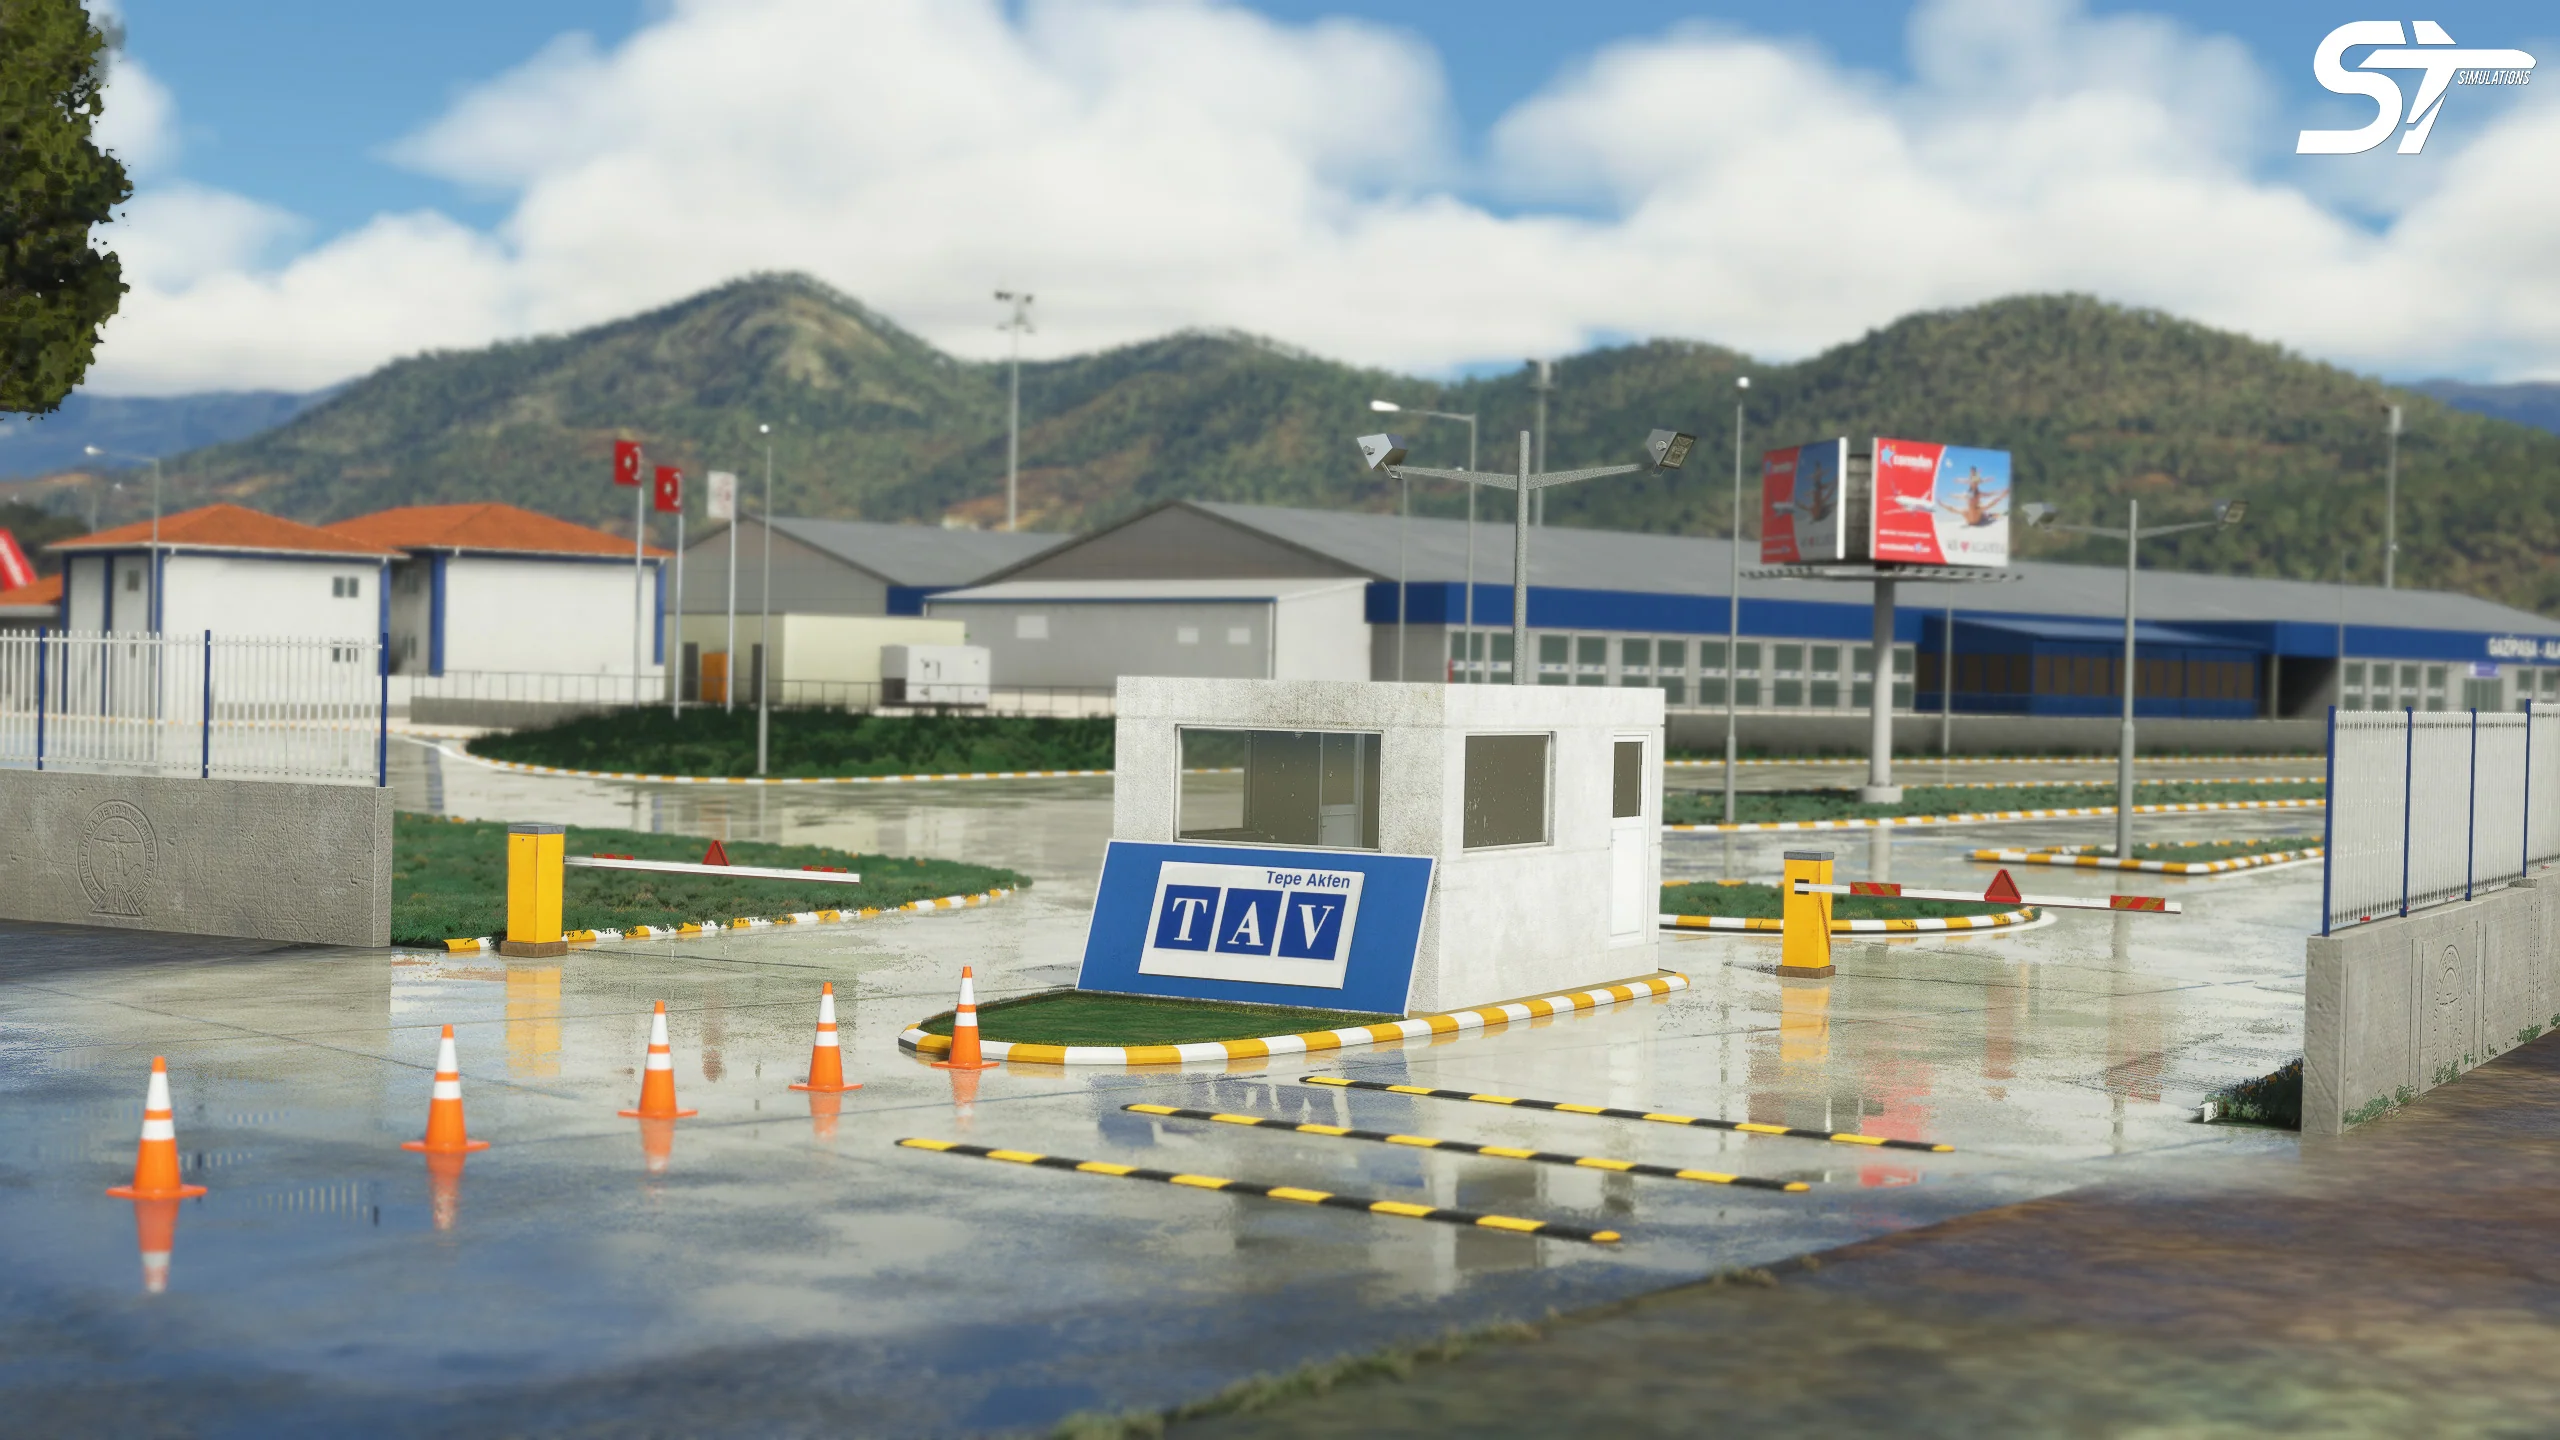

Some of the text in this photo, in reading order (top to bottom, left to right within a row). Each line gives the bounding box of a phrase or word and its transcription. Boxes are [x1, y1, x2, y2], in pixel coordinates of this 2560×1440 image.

[1266, 870, 1351, 889] Tepe Akfen
[1172, 897, 1334, 949] TAV
